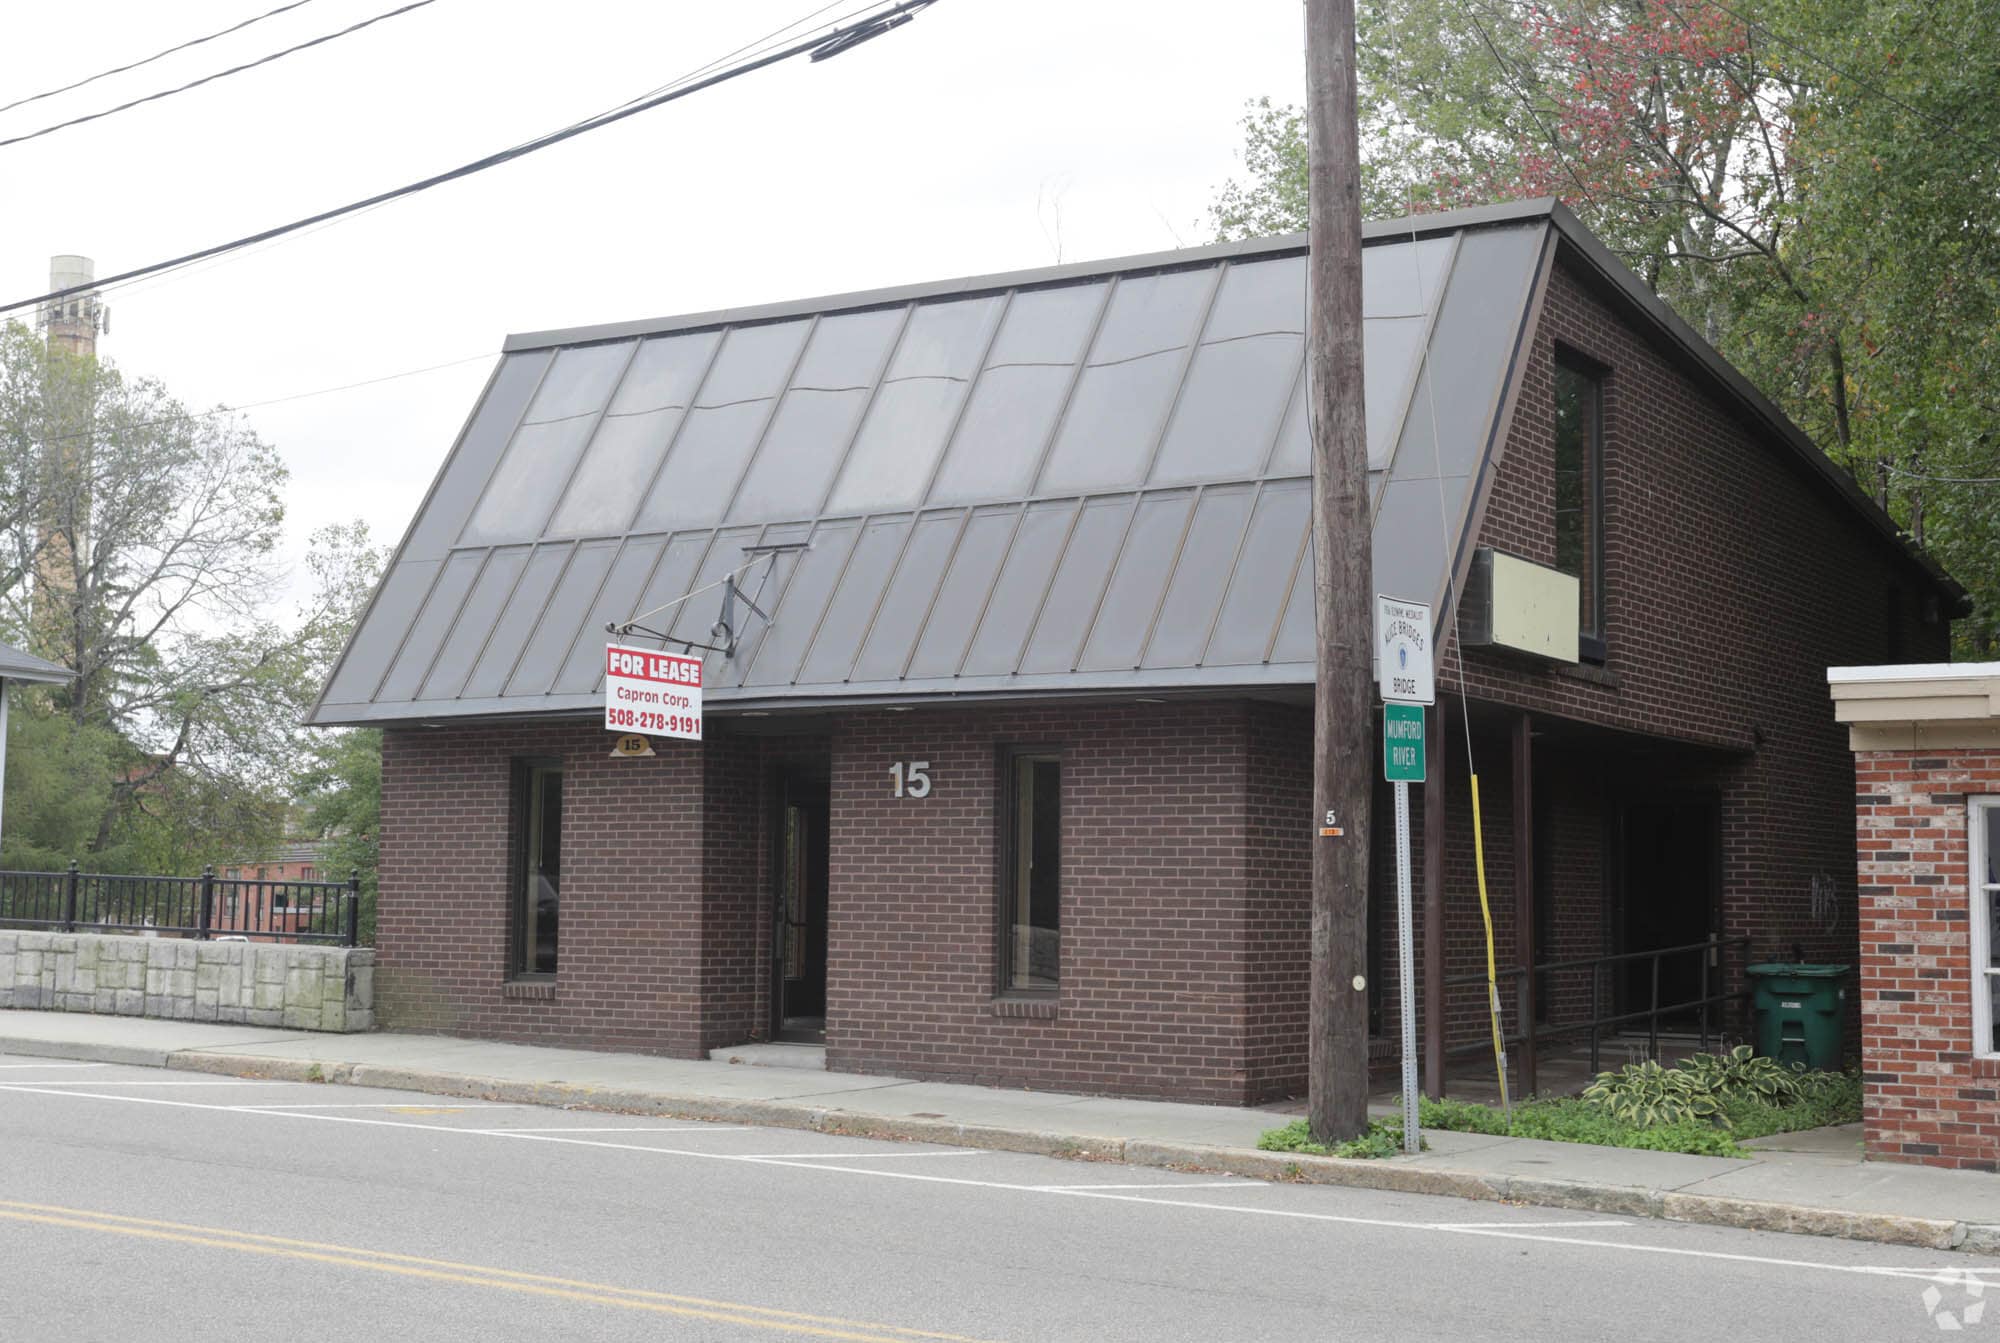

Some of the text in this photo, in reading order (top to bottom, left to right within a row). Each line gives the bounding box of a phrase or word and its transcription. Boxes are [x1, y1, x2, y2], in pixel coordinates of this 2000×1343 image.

[1398, 620, 1424, 651] BRIDGES
[610, 652, 699, 684] FOR LEASE
[1393, 677, 1416, 695] BRIDGE
[617, 686, 692, 710] Capron Corp.
[1387, 719, 1422, 740] MUMFORD
[625, 739, 640, 751] 15
[1393, 746, 1416, 767] RIVER
[889, 761, 931, 798] 15
[1326, 810, 1336, 825] 5
